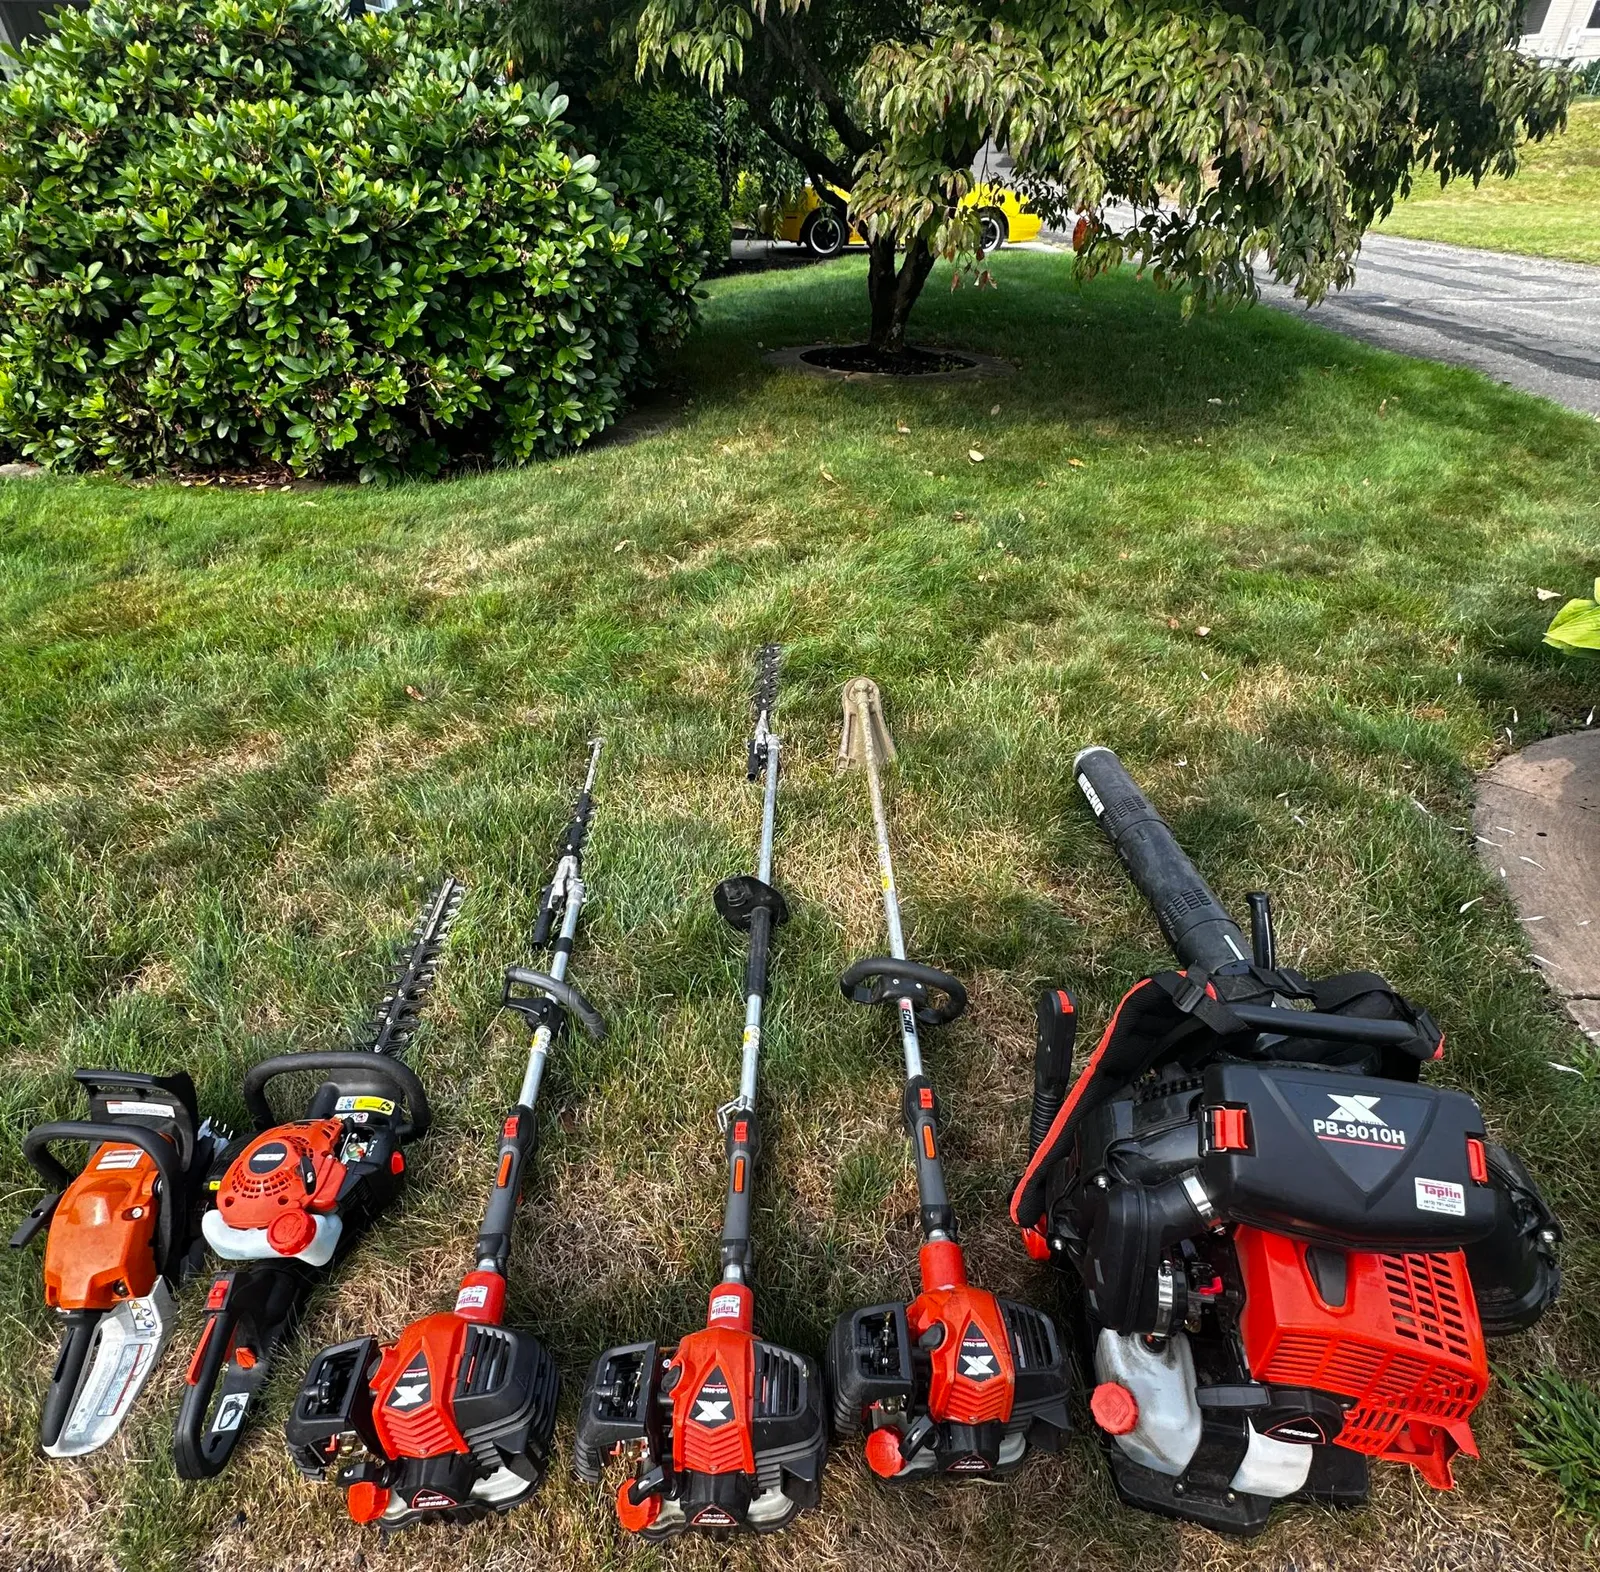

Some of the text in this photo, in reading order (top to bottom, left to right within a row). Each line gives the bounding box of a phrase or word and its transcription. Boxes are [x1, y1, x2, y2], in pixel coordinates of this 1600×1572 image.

[1081, 778, 1105, 817] ECHO
[902, 1008, 915, 1034] ECHO
[1313, 1119, 1406, 1145] PB-9010H
[1418, 1183, 1461, 1199] Taplin
